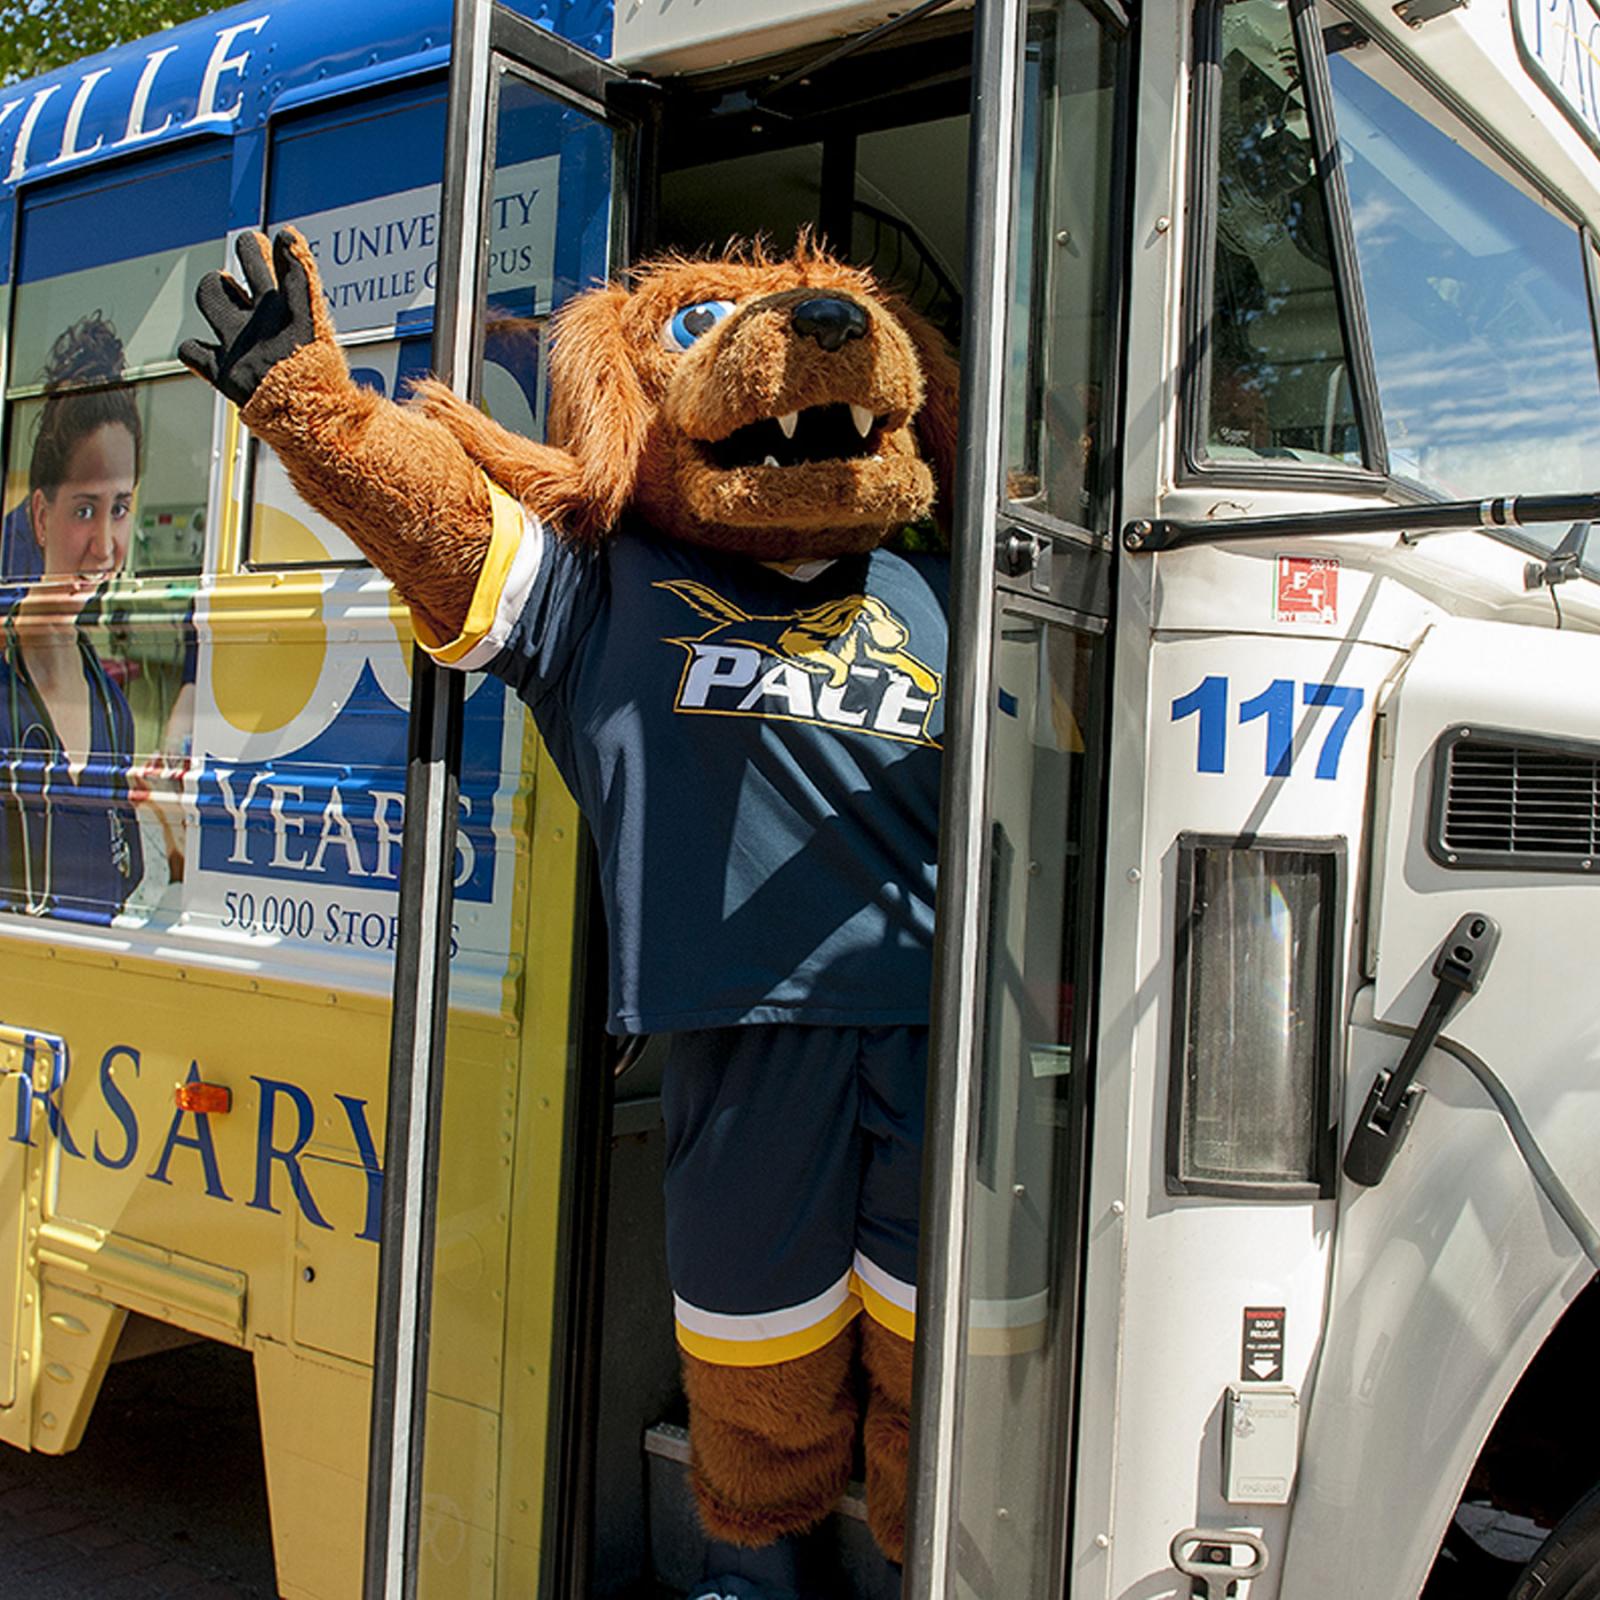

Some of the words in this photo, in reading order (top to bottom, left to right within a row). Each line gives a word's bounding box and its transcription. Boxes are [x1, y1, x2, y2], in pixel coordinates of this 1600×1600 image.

[0, 15, 269, 184] ILLE
[333, 190, 539, 266] UNIVETY
[680, 643, 929, 737] PACE
[1171, 676, 1365, 780] 117
